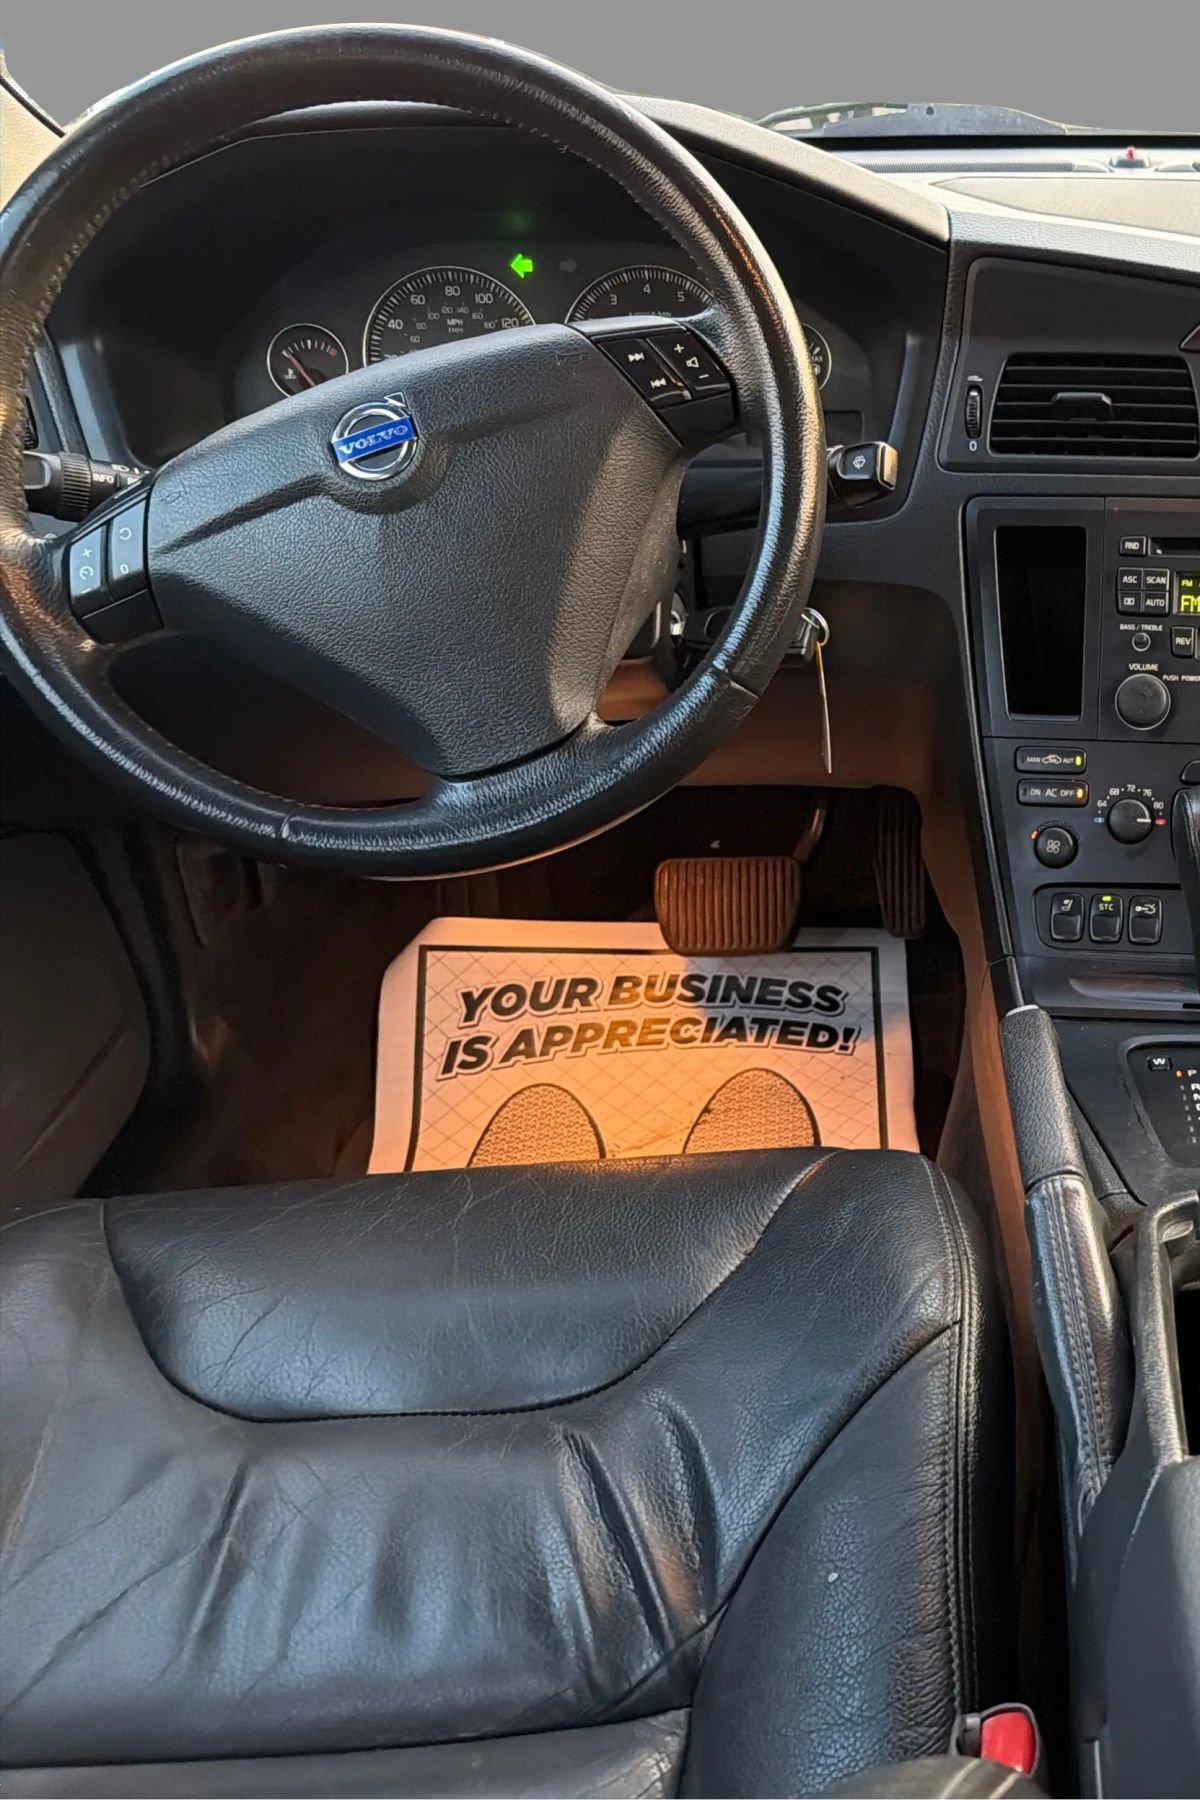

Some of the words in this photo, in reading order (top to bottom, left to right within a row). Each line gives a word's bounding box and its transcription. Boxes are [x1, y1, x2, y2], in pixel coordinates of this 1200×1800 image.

[445, 286, 461, 297] 80
[643, 284, 651, 294] 4
[410, 294, 426, 305] 60
[475, 293, 493, 304] 100
[610, 294, 618, 305] 3
[677, 291, 685, 302] 5
[388, 319, 403, 329] 40
[502, 317, 519, 329] 120
[338, 425, 408, 455] VOLVO
[93, 473, 114, 484] INFO
[1125, 542, 1140, 550] RND
[1122, 576, 1138, 584] ASC
[1146, 576, 1167, 584] SCAN
[1145, 599, 1165, 607] AUTO
[1180, 595, 1200, 612] FM
[1175, 637, 1191, 645] REV
[1128, 663, 1159, 671] VOLUME
[1045, 788, 1057, 797] AC
[1126, 784, 1136, 793] 72
[1142, 788, 1152, 797] 76
[1097, 800, 1107, 808] 64
[1153, 801, 1164, 810] 80
[1098, 903, 1114, 911] STC
[458, 976, 600, 1022] YOUR
[607, 974, 848, 1015] BUSINESS
[440, 1036, 494, 1075] IS
[503, 1016, 860, 1064] APPRECIATED!
[1187, 1069, 1198, 1077] P
